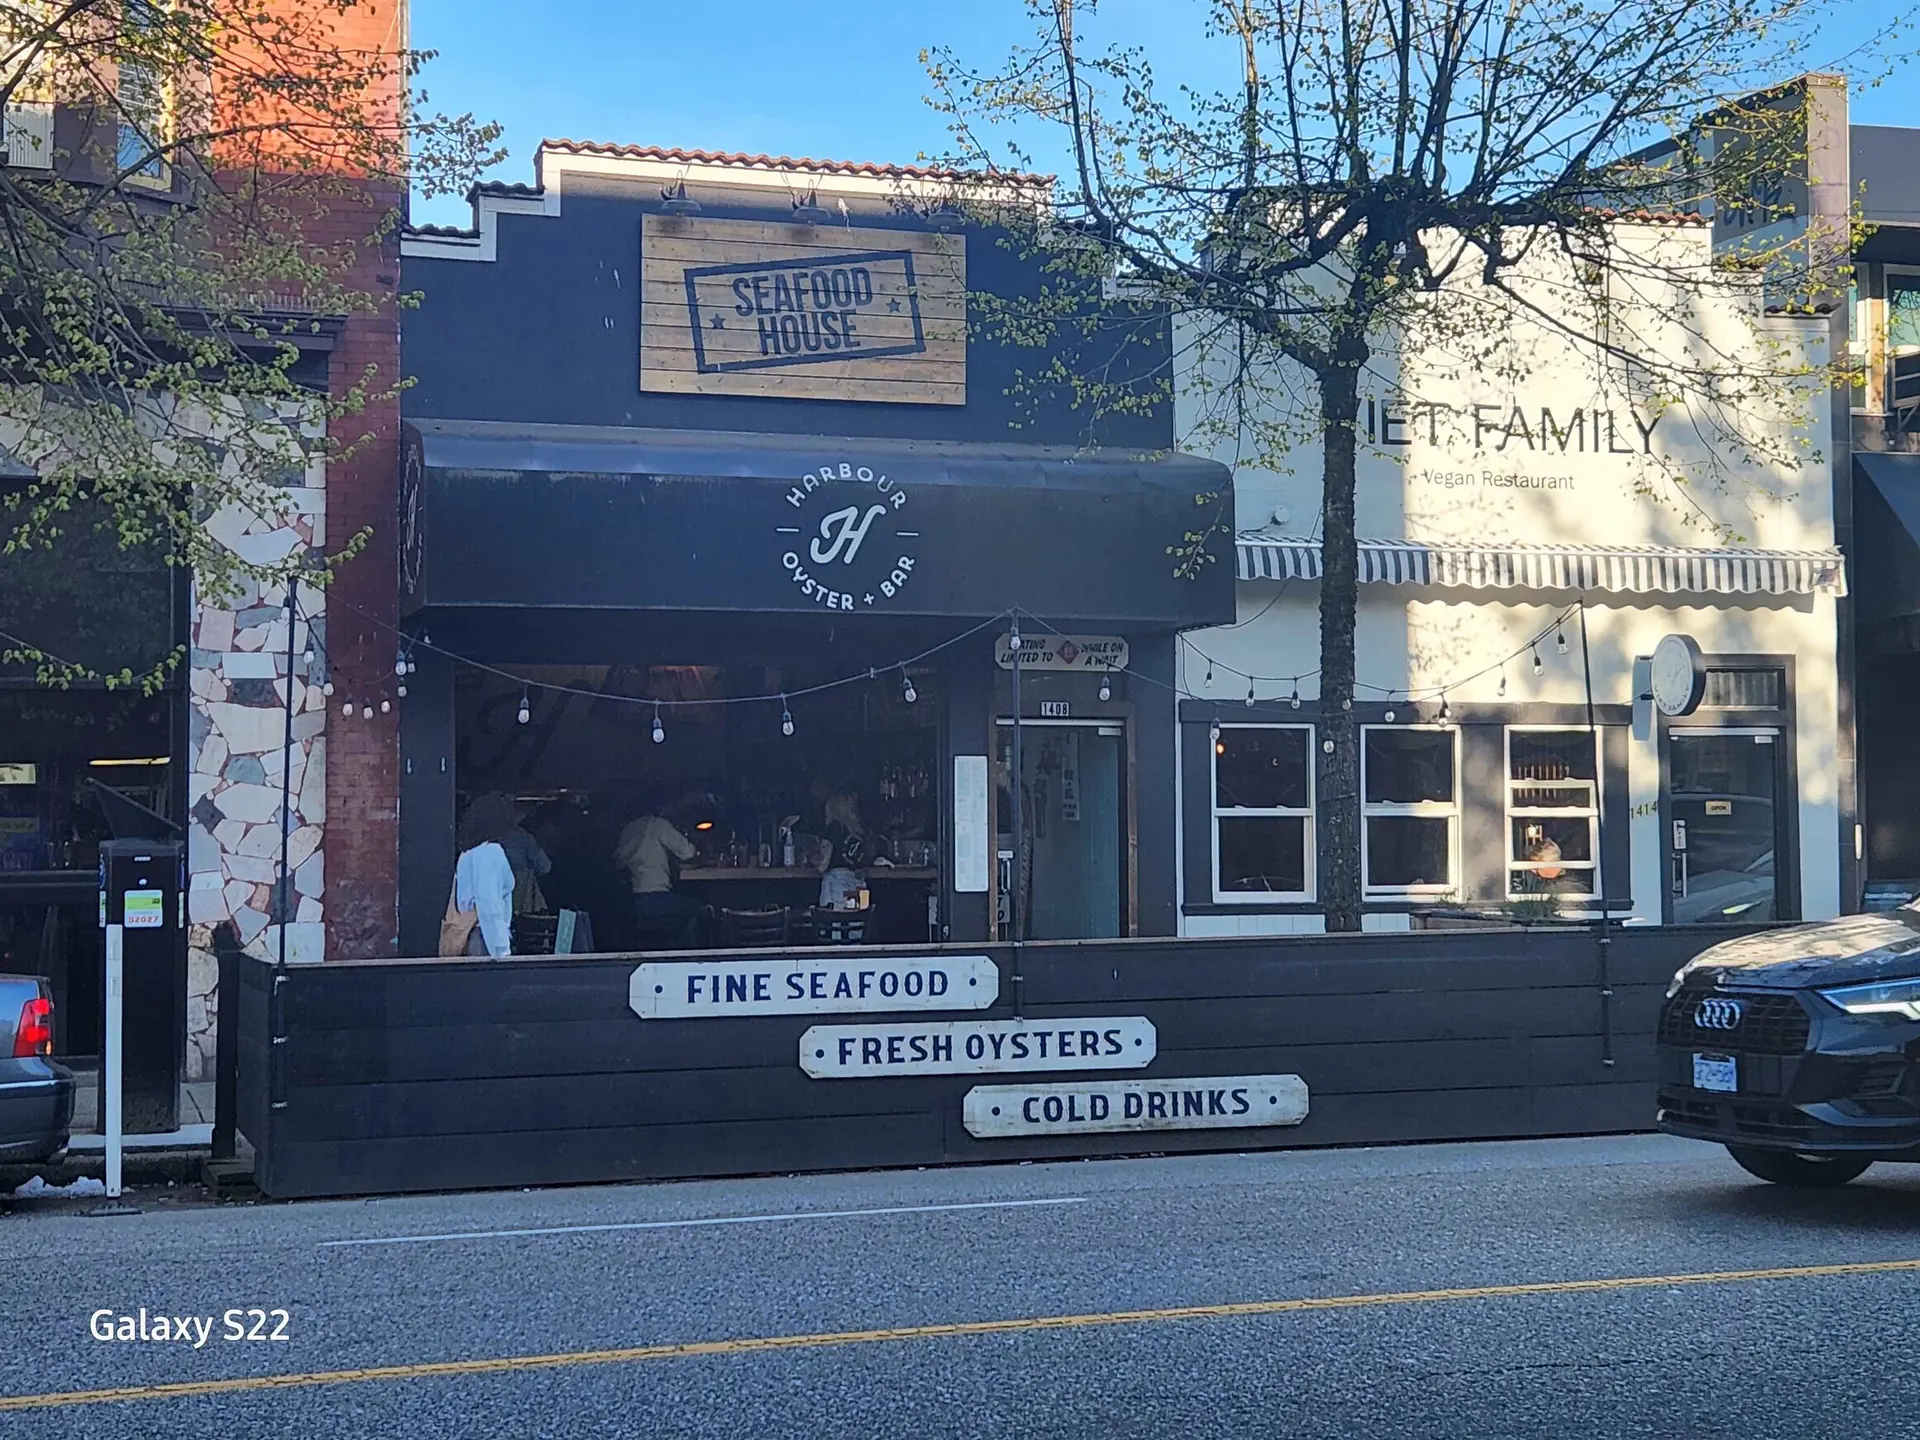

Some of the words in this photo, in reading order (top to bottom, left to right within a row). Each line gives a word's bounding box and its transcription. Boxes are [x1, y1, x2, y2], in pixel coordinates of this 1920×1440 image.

[732, 267, 873, 316] SEAFOOD
[757, 308, 861, 356] HOUSE
[1355, 398, 1451, 446] IET
[1474, 404, 1661, 454] FAMILY
[786, 462, 907, 509] HARBOUR
[1423, 468, 1475, 489] Vegan
[1482, 470, 1575, 490] Restaurant
[810, 504, 887, 564] H
[782, 551, 854, 610] OYSTER
[880, 555, 916, 598] BAR
[1008, 639, 1046, 650] ATING
[1041, 651, 1054, 663] TO
[1081, 642, 1109, 653] WHILE
[1111, 642, 1124, 653] ON
[1084, 655, 1093, 665] A
[1043, 703, 1068, 715] 1408
[1630, 801, 1657, 819] 1414
[687, 973, 772, 1003] FINE
[786, 970, 949, 1000] SEAFOOD
[838, 1034, 953, 1065] FRESH
[965, 1029, 1123, 1060] OYSTERS
[1022, 1094, 1109, 1123] COLD
[1124, 1088, 1251, 1119] DRINKS
